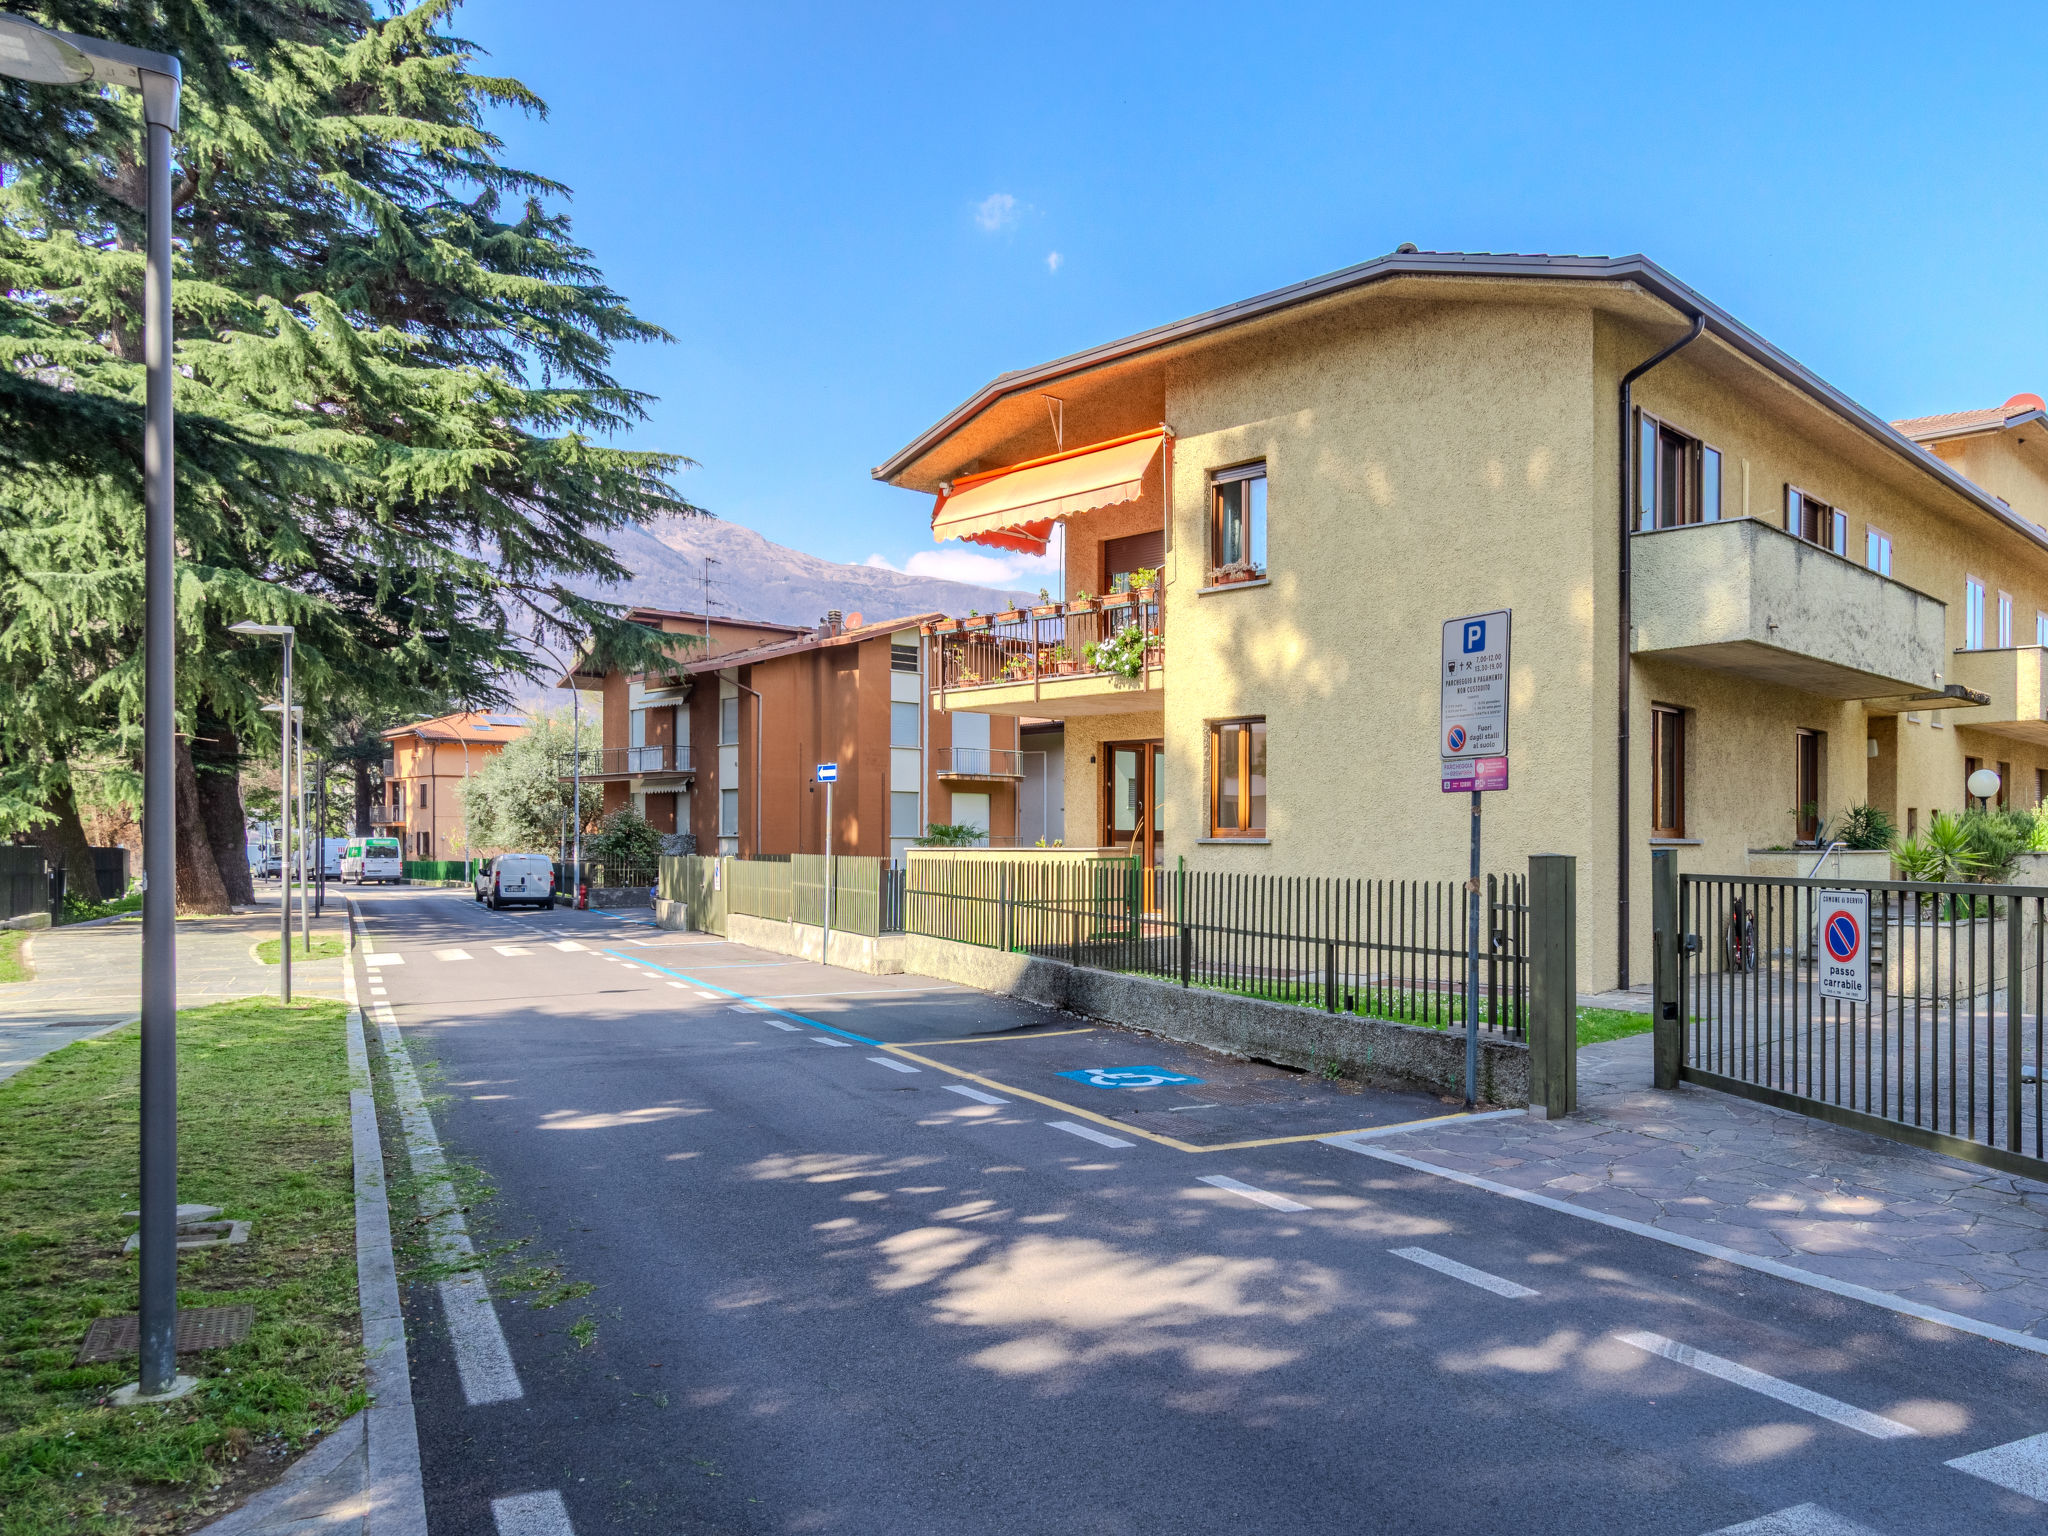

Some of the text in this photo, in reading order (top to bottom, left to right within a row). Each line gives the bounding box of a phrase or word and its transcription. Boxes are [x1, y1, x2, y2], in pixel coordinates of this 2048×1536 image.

[1467, 625, 1482, 650] P
[1445, 677, 1473, 687] PARCHEGGIO
[1477, 673, 1503, 684] PAGAMENTO
[1456, 684, 1491, 694] NON CUSTODITO
[1477, 724, 1492, 732] Fuori
[1484, 731, 1500, 740] stalli
[1479, 741, 1496, 749] suolo
[1822, 896, 1840, 904] COMUNE
[1846, 896, 1864, 905] DERVIO
[1830, 966, 1855, 977] passo
[1823, 978, 1862, 991] carrabile
